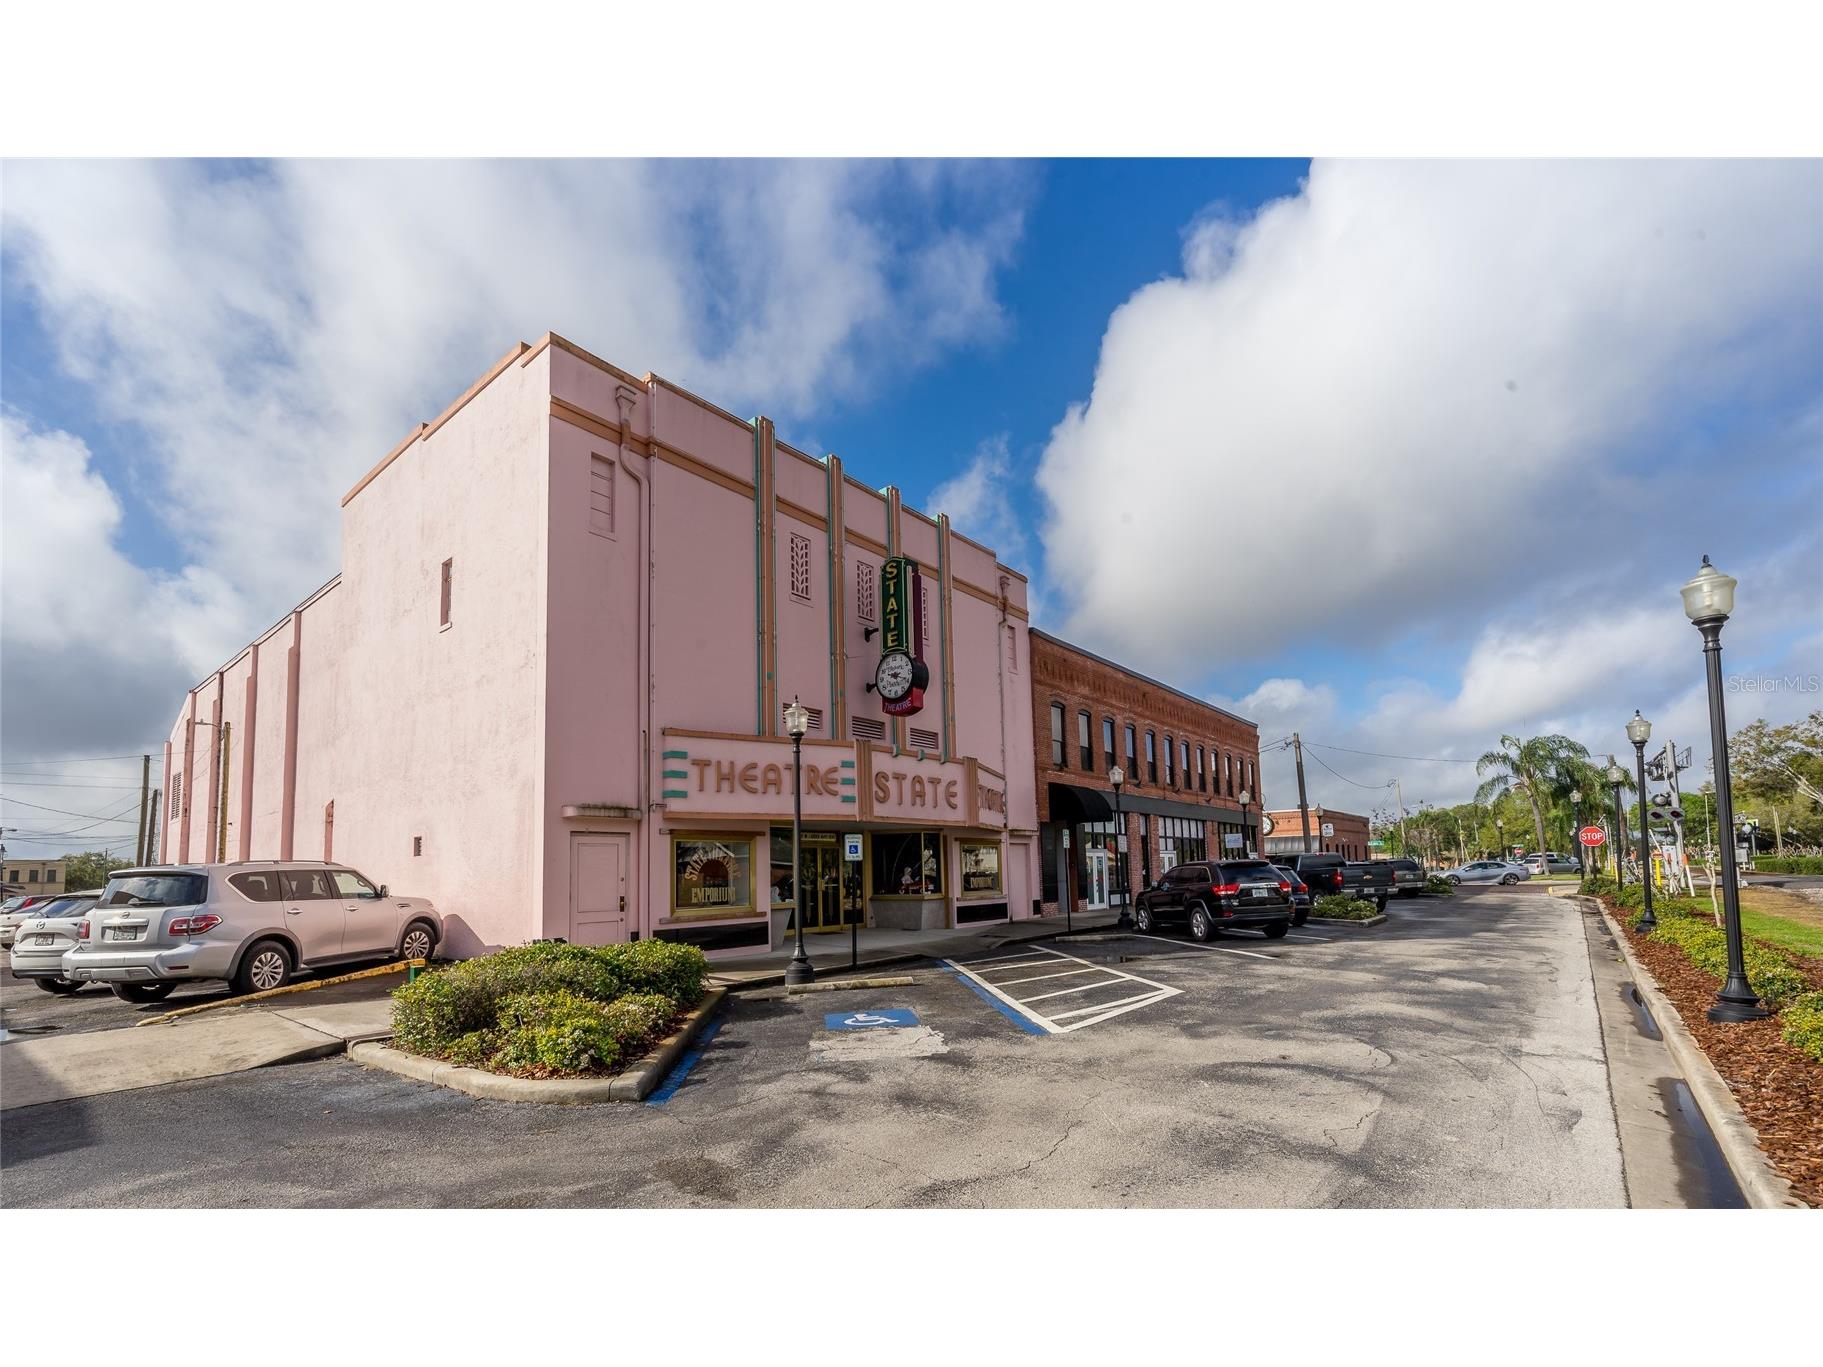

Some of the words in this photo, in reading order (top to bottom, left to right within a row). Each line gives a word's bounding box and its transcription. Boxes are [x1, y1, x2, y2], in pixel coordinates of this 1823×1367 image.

[885, 562, 898, 647] STATE
[884, 698, 911, 712] THEATRE
[691, 759, 839, 796] THEATRE
[875, 771, 958, 810] STATE
[1581, 832, 1603, 840] STOP
[691, 887, 736, 903] EMPORIUM
